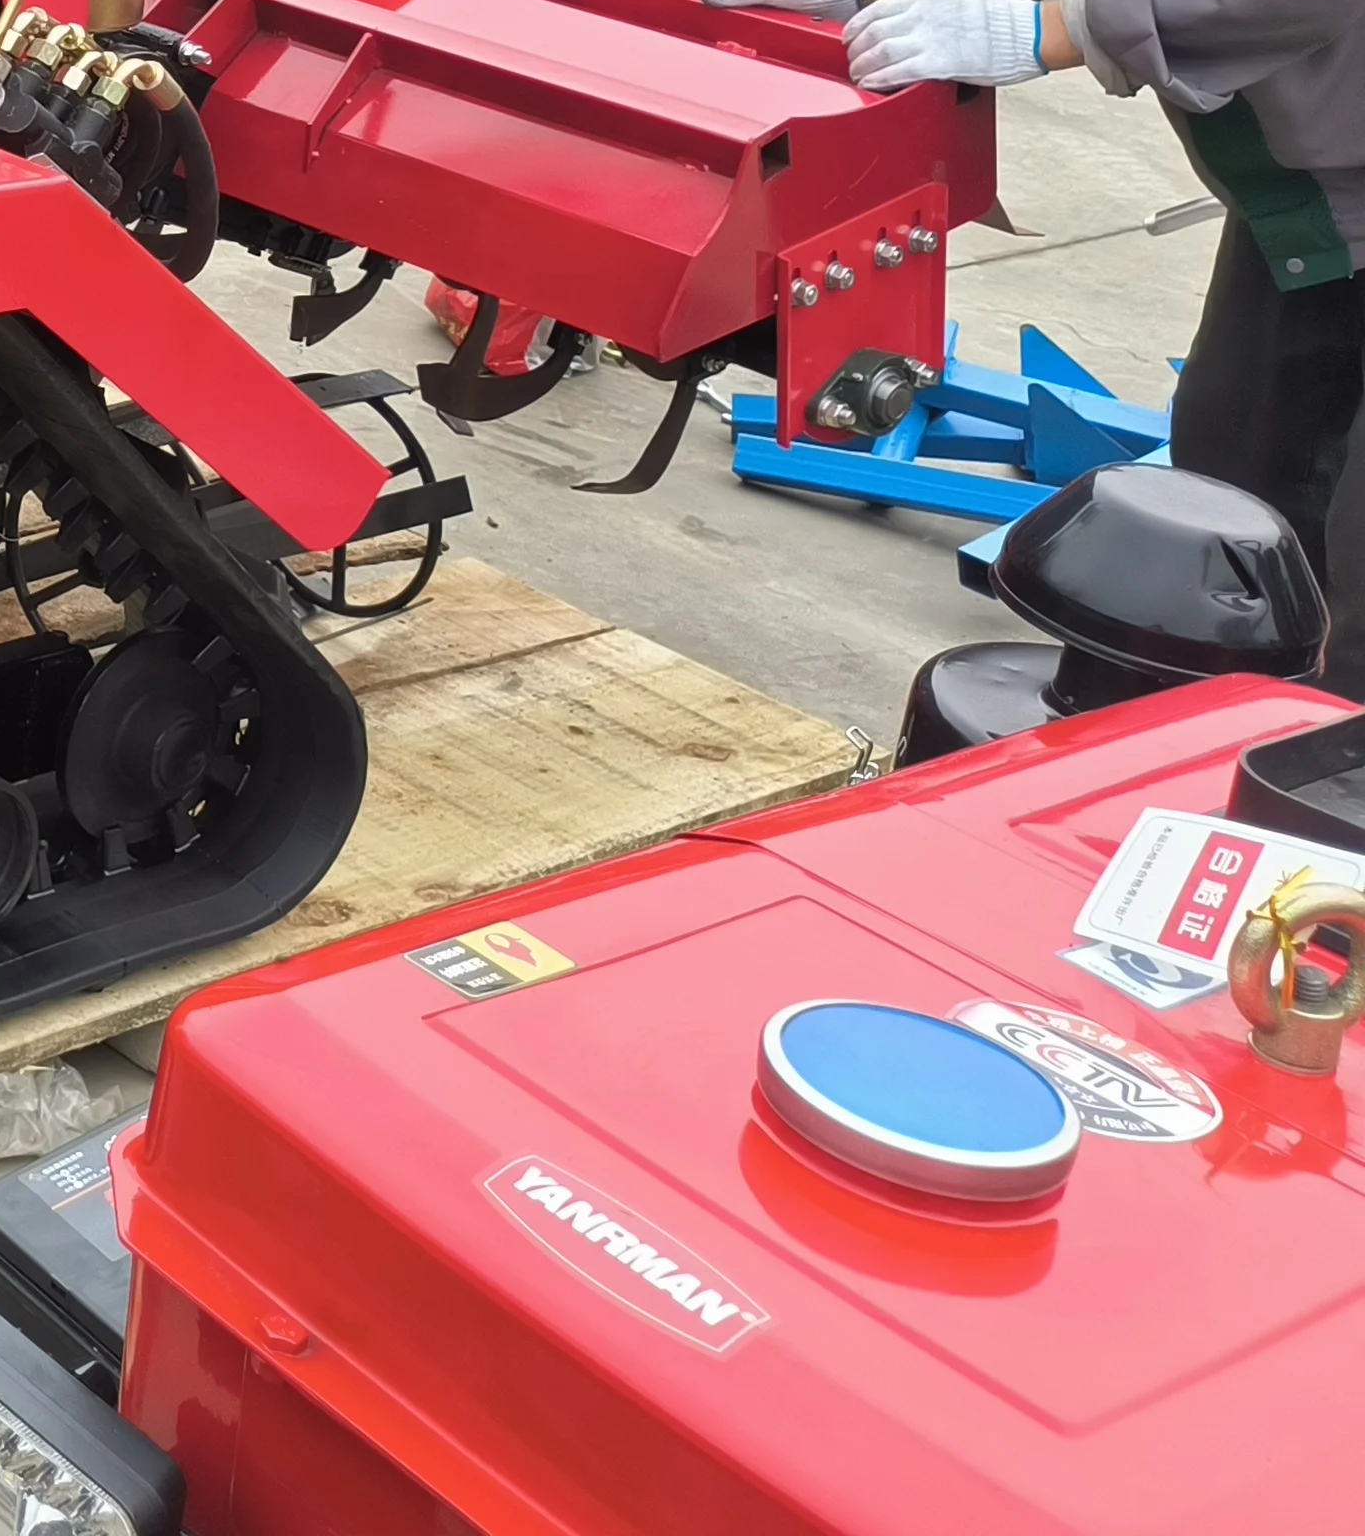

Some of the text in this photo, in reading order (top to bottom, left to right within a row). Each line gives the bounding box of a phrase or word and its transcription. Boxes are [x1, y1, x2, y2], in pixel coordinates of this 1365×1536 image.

[1177, 846, 1244, 943] 合格证
[995, 1022, 1180, 1108] CCTV
[513, 1166, 740, 1326] YANRMAN
